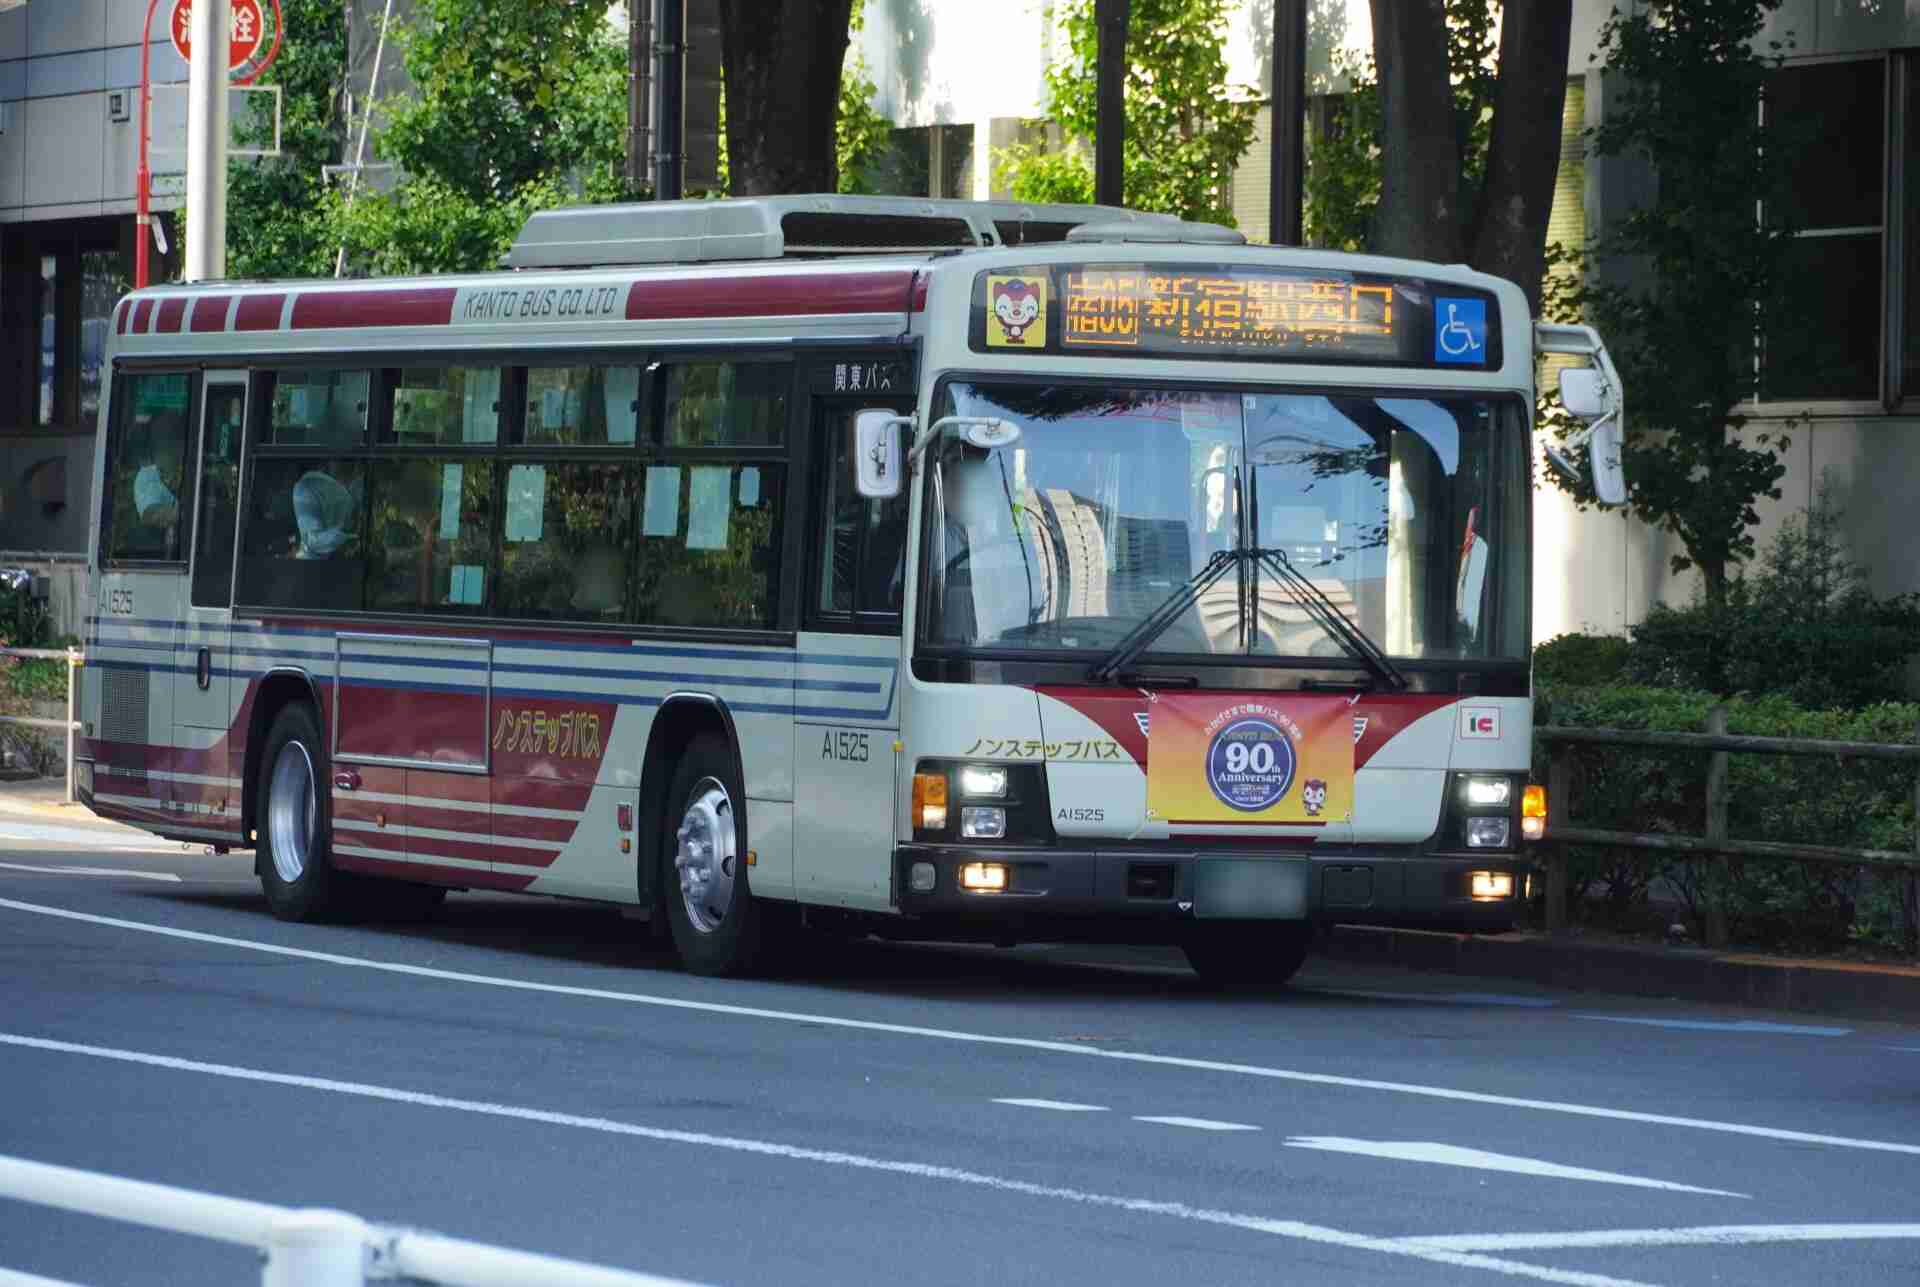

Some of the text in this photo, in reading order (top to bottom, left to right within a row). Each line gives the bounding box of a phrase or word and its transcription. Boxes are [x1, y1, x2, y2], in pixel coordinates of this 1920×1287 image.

[464, 291, 519, 319] KANTO
[519, 288, 557, 317] BUS
[834, 361, 896, 392] 関東バス
[492, 708, 601, 759] ノンステップバス
[822, 730, 869, 762] A1525
[965, 738, 1121, 759] ノンステップバス
[1218, 771, 1283, 785] Anniversary
[1056, 807, 1105, 822] A1525
